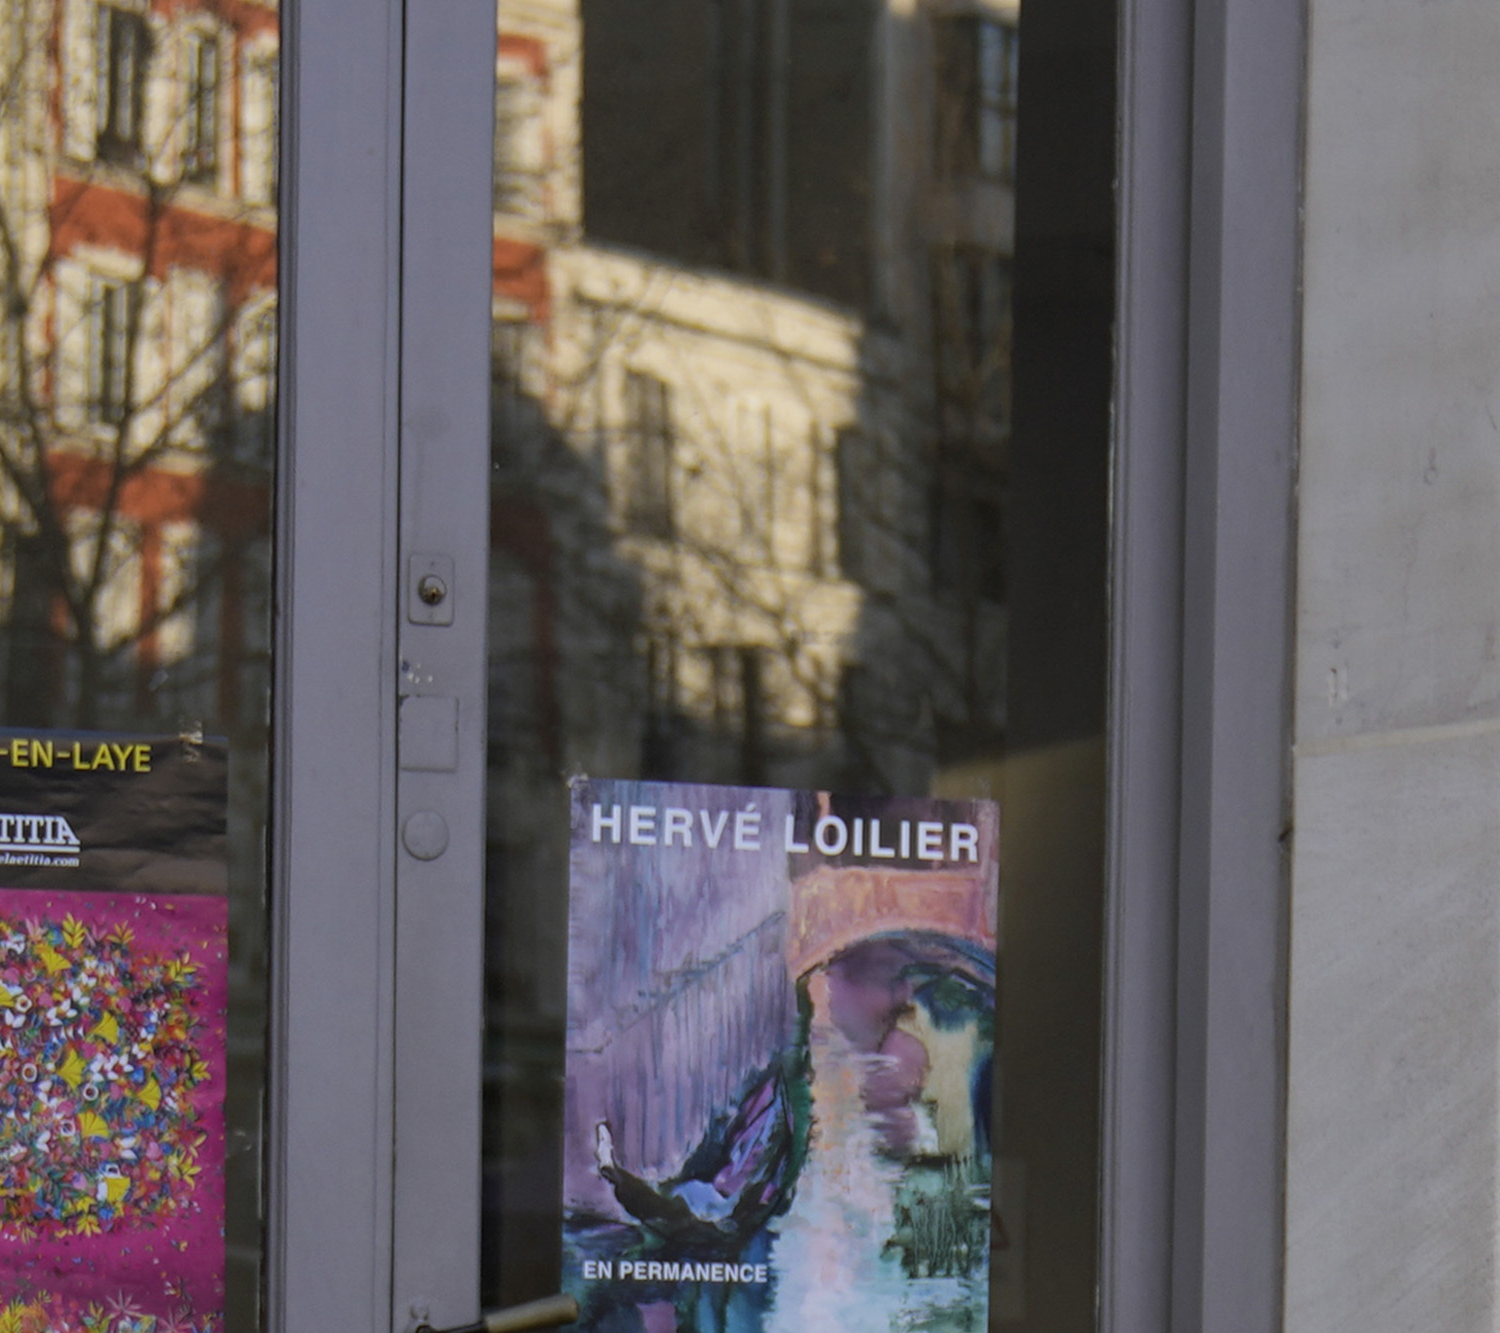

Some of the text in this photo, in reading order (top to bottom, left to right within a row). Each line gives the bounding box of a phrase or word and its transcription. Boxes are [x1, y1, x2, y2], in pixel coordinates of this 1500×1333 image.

[592, 803, 979, 862] HERVÉ LOILIER
[583, 1260, 767, 1283] EN PERMANENCE
